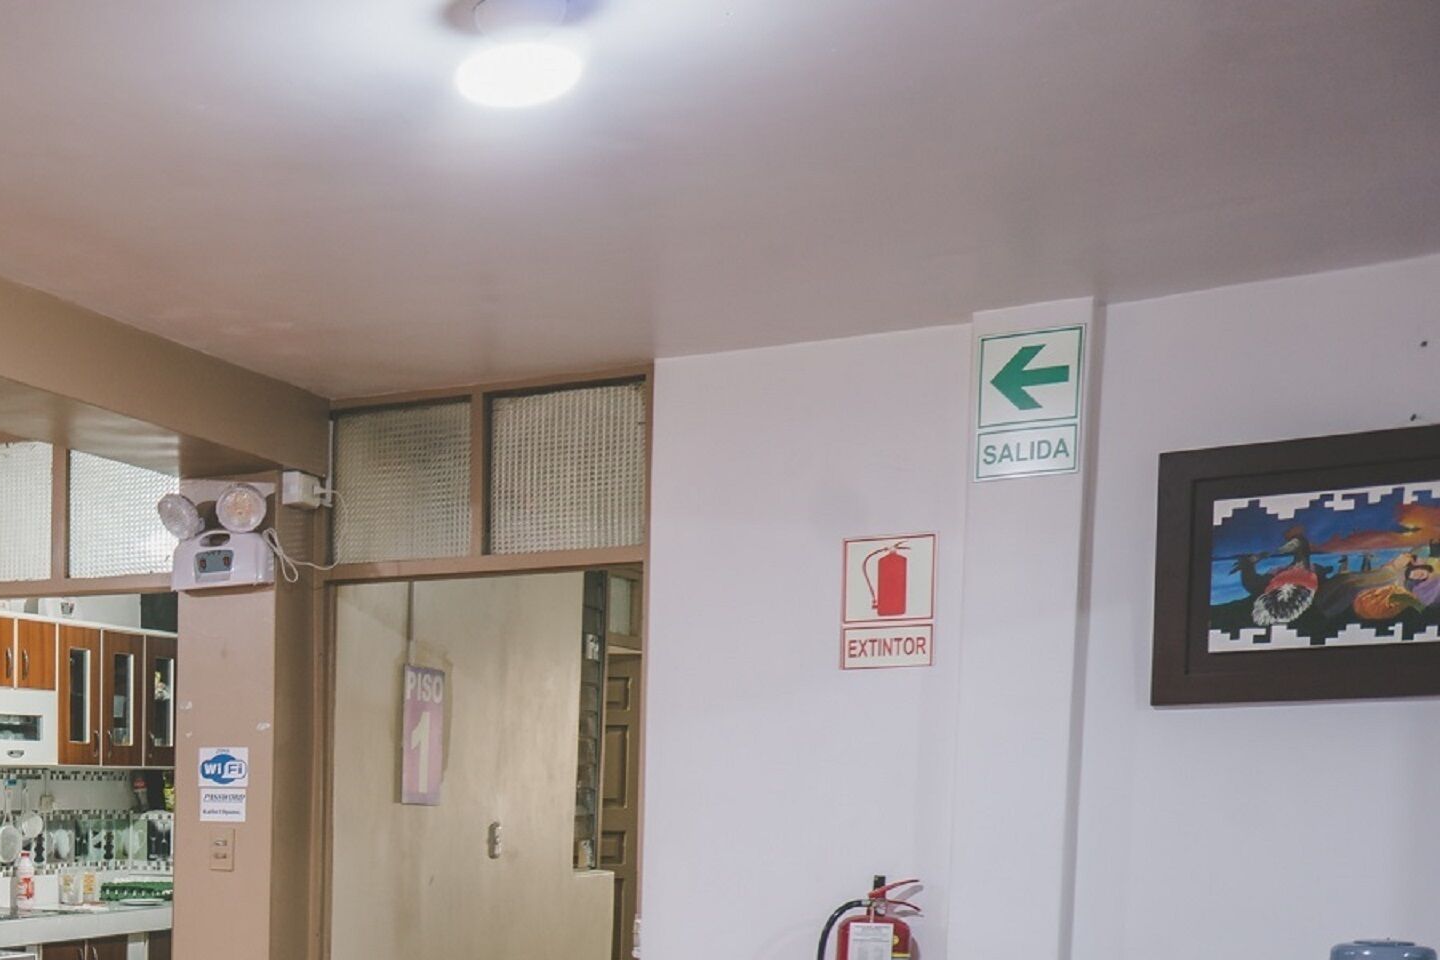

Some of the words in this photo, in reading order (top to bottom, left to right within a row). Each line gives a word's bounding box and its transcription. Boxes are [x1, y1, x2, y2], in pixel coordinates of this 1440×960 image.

[982, 437, 1070, 465] SALIDA
[848, 636, 926, 659] EXTINTOR
[405, 670, 444, 704] PISO
[411, 711, 431, 794] 1
